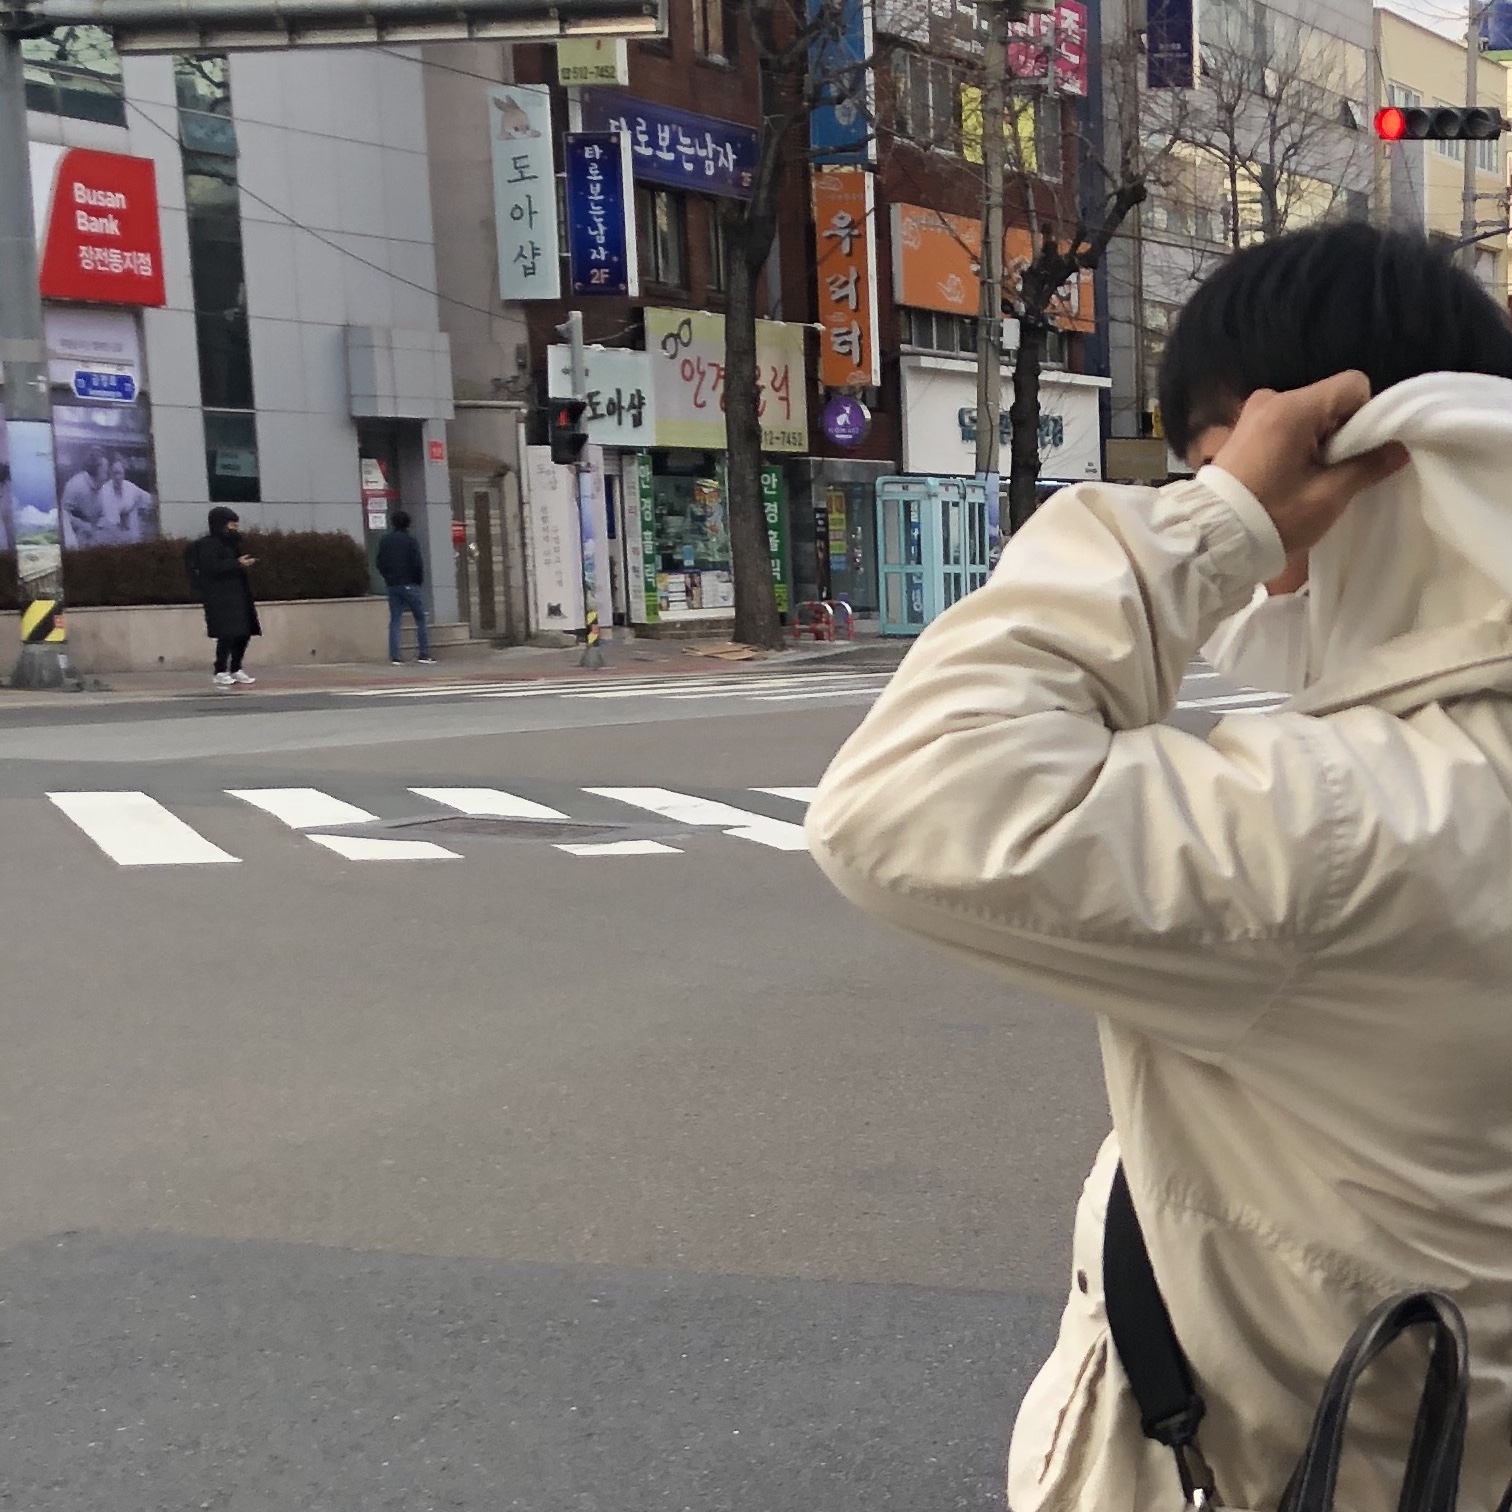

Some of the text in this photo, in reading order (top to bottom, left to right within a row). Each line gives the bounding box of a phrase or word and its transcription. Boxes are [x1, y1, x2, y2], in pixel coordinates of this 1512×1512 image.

[73, 182, 127, 209] Busan
[75, 210, 121, 235] Bank
[507, 154, 542, 278] 도아샵
[78, 245, 153, 277] 장전동지점
[590, 268, 610, 284] 2F
[822, 209, 862, 366] 우리터
[586, 387, 646, 429] 도아샵
